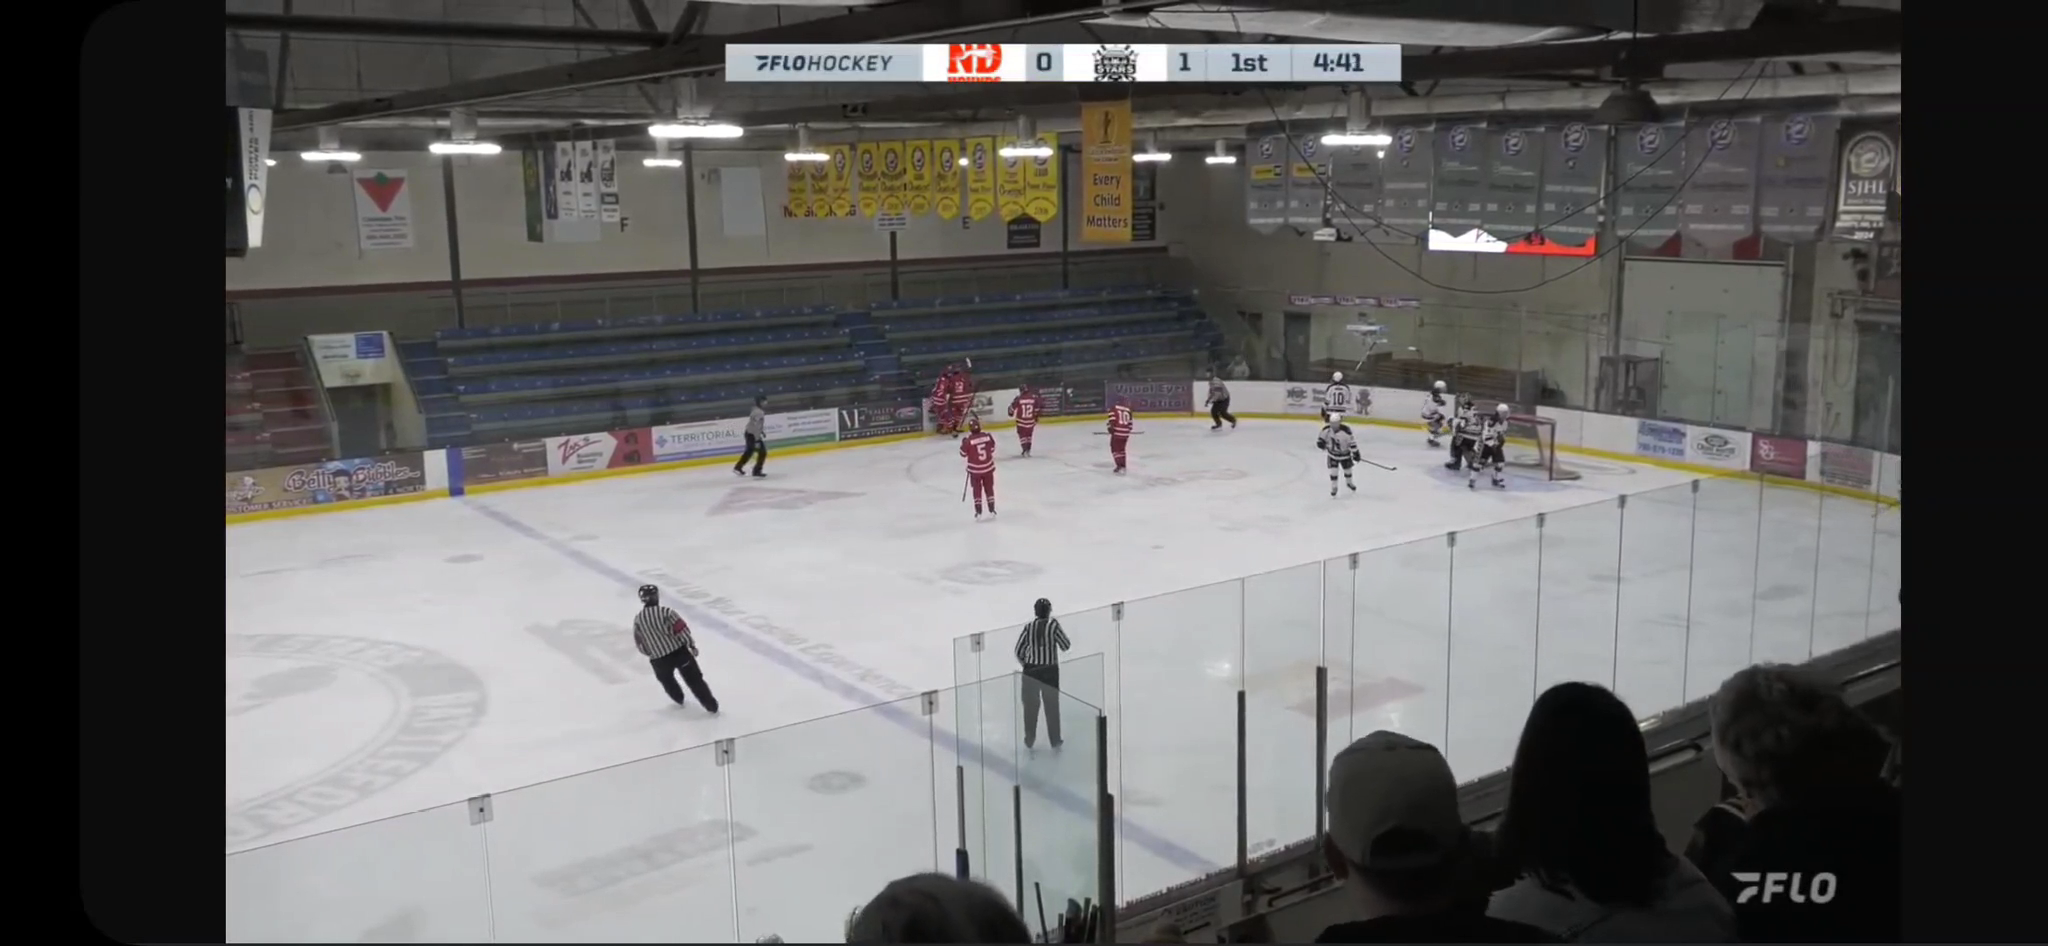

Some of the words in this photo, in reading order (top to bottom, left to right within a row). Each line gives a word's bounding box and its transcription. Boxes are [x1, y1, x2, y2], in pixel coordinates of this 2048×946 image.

[1092, 173, 1122, 190] Every
[1847, 180, 1888, 196] SJHL
[1093, 192, 1121, 207] Child
[620, 216, 629, 232] F
[1086, 215, 1129, 228] Matters
[1332, 392, 1345, 406] 10
[1021, 405, 1034, 418] 12
[1117, 410, 1131, 425] 10
[671, 430, 736, 443] TERRITORIAL
[976, 444, 987, 462] 5
[285, 469, 337, 493] Belly
[351, 461, 420, 488] Bubbles
